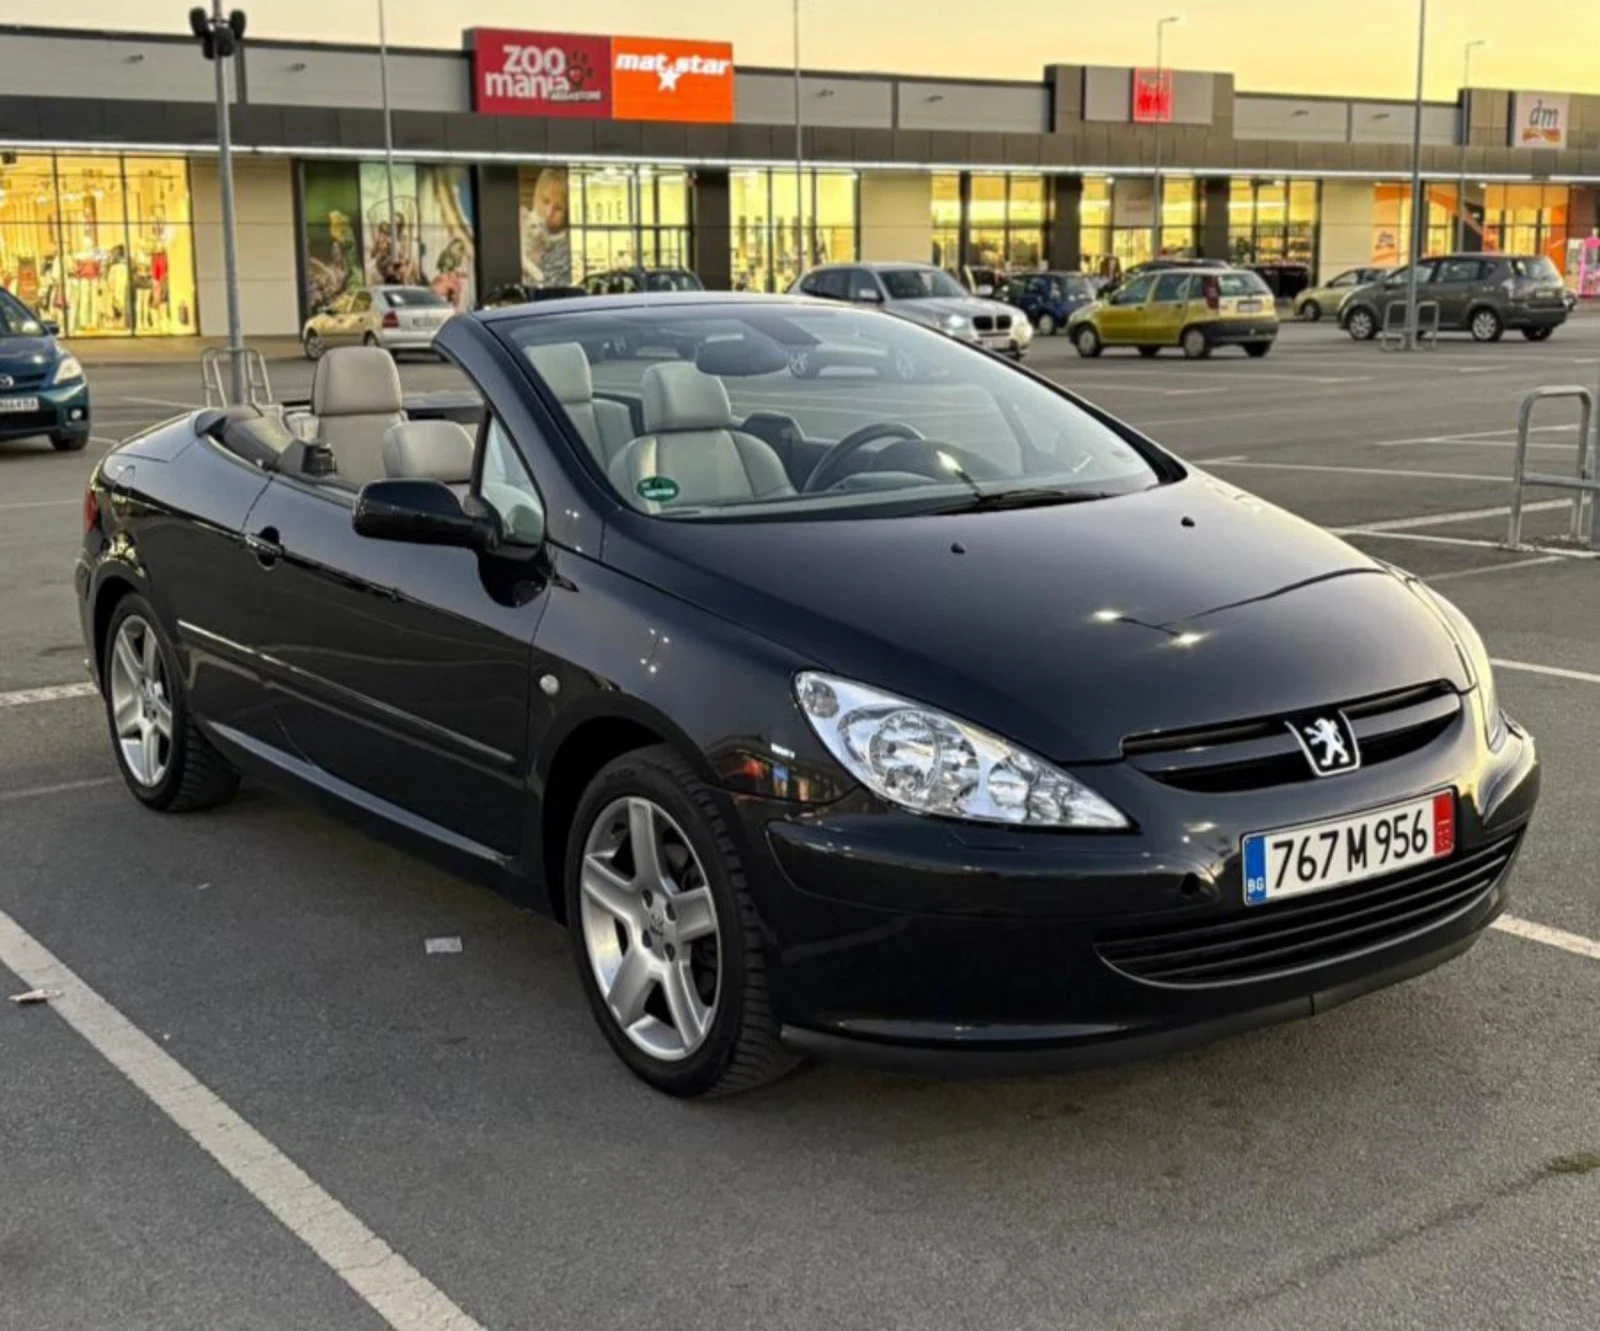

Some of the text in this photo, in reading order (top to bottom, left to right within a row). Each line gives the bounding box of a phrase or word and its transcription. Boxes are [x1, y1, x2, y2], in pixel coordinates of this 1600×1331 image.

[1529, 98, 1559, 127] dm
[1272, 828, 1340, 889] 767
[1346, 823, 1368, 873] M
[1374, 809, 1428, 865] 956
[1247, 876, 1265, 894] BG
